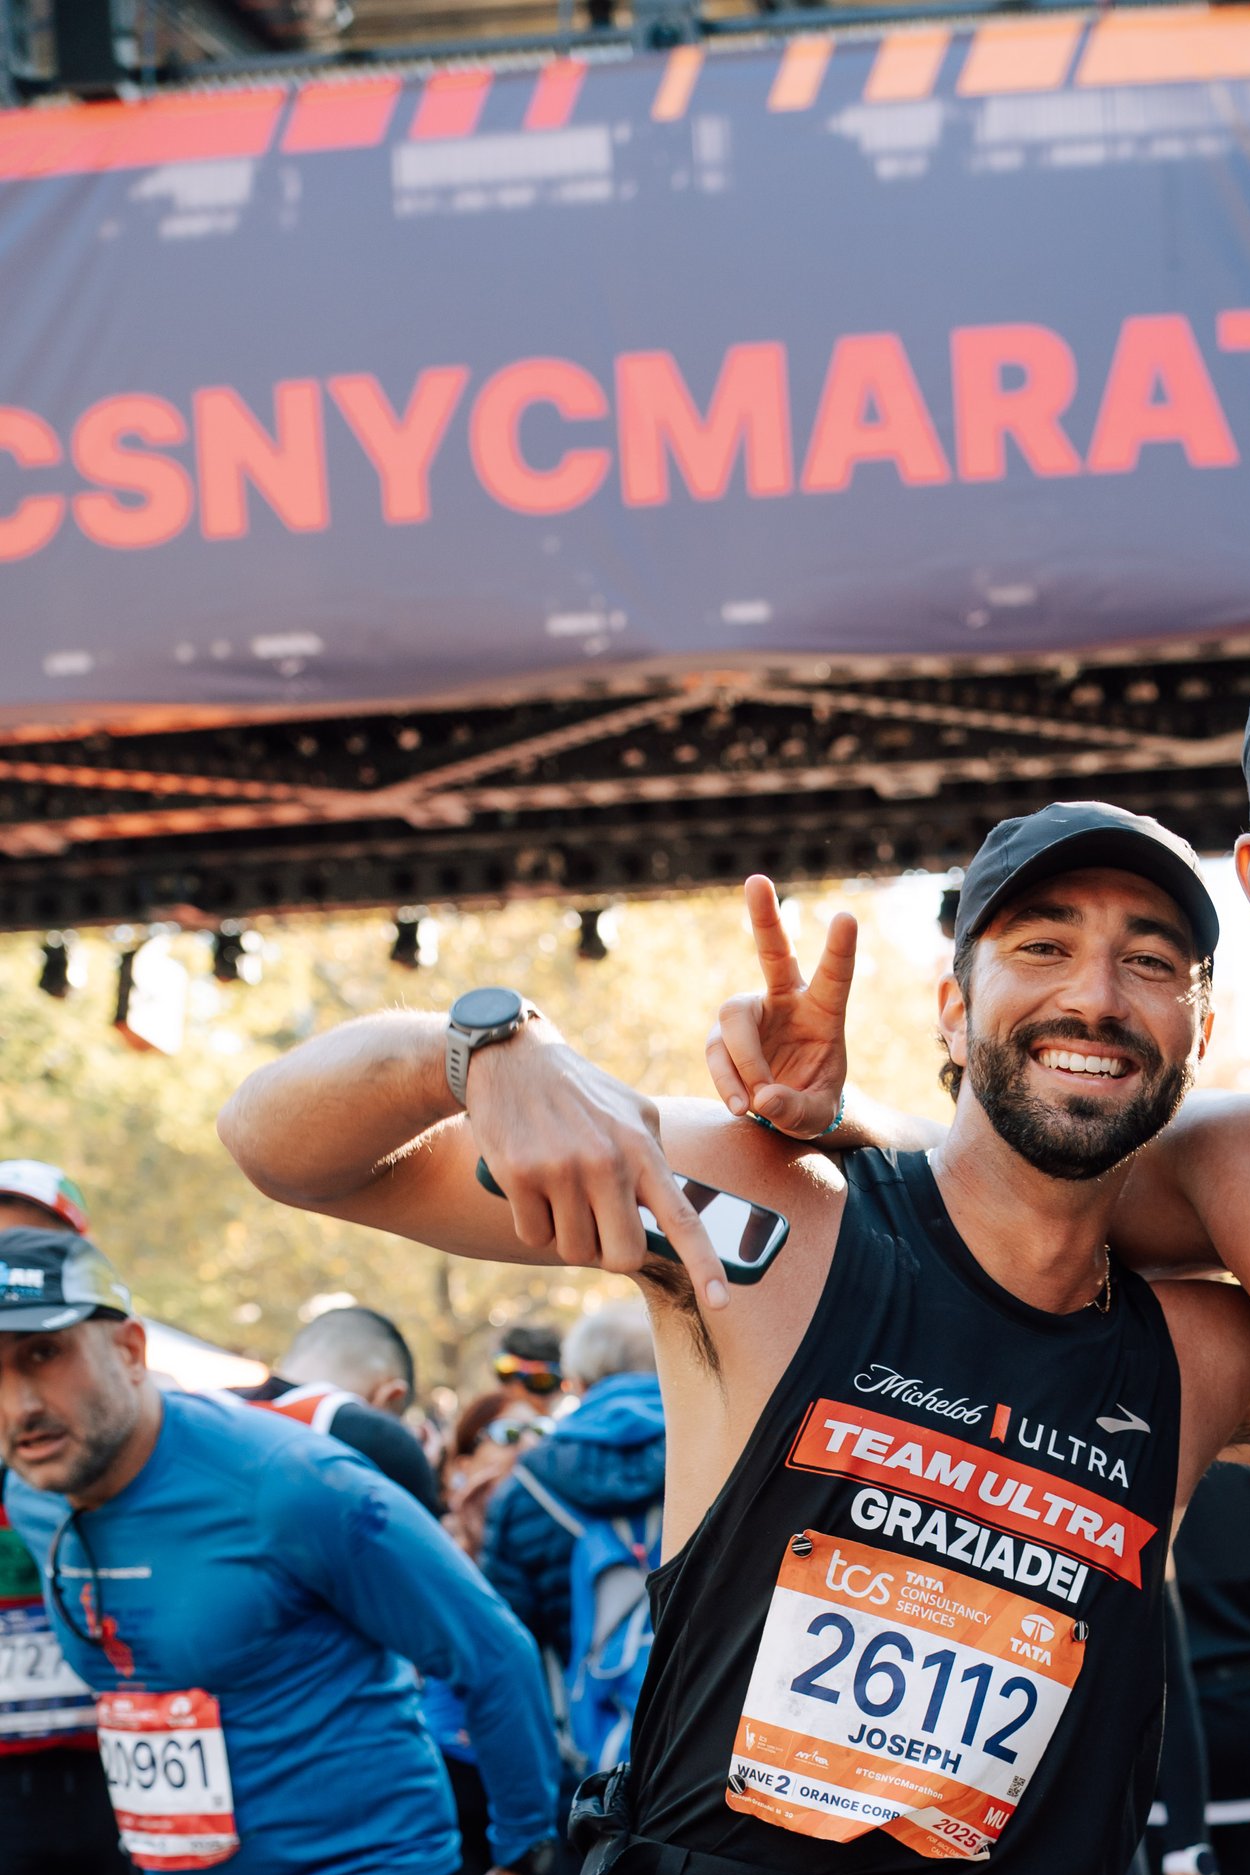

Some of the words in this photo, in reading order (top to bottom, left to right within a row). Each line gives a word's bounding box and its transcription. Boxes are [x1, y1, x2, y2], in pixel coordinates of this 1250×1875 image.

[853, 1363, 989, 1425] Michelob
[1018, 1417, 1130, 1489] ULTRA
[823, 1419, 976, 1492] TEAM
[976, 1471, 1125, 1557] ULTRA
[850, 1488, 1089, 1604] GRAZIADEI
[824, 1549, 894, 1605] tcs
[905, 1570, 944, 1592] TATA
[896, 1600, 956, 1628] SERVICES
[900, 1585, 991, 1627] CONSULTANCY
[1009, 1636, 1052, 1666] TATA
[790, 1611, 1039, 1765] 26112
[847, 1723, 962, 1775] JOSEPH
[737, 1763, 774, 1787] WAVE
[774, 1774, 791, 1795] 2
[799, 1786, 860, 1812] ORANGE
[855, 1766, 944, 1800] #TCSNYCMarathon
[932, 1818, 982, 1848] 2025
[982, 1806, 1010, 1831] MU
